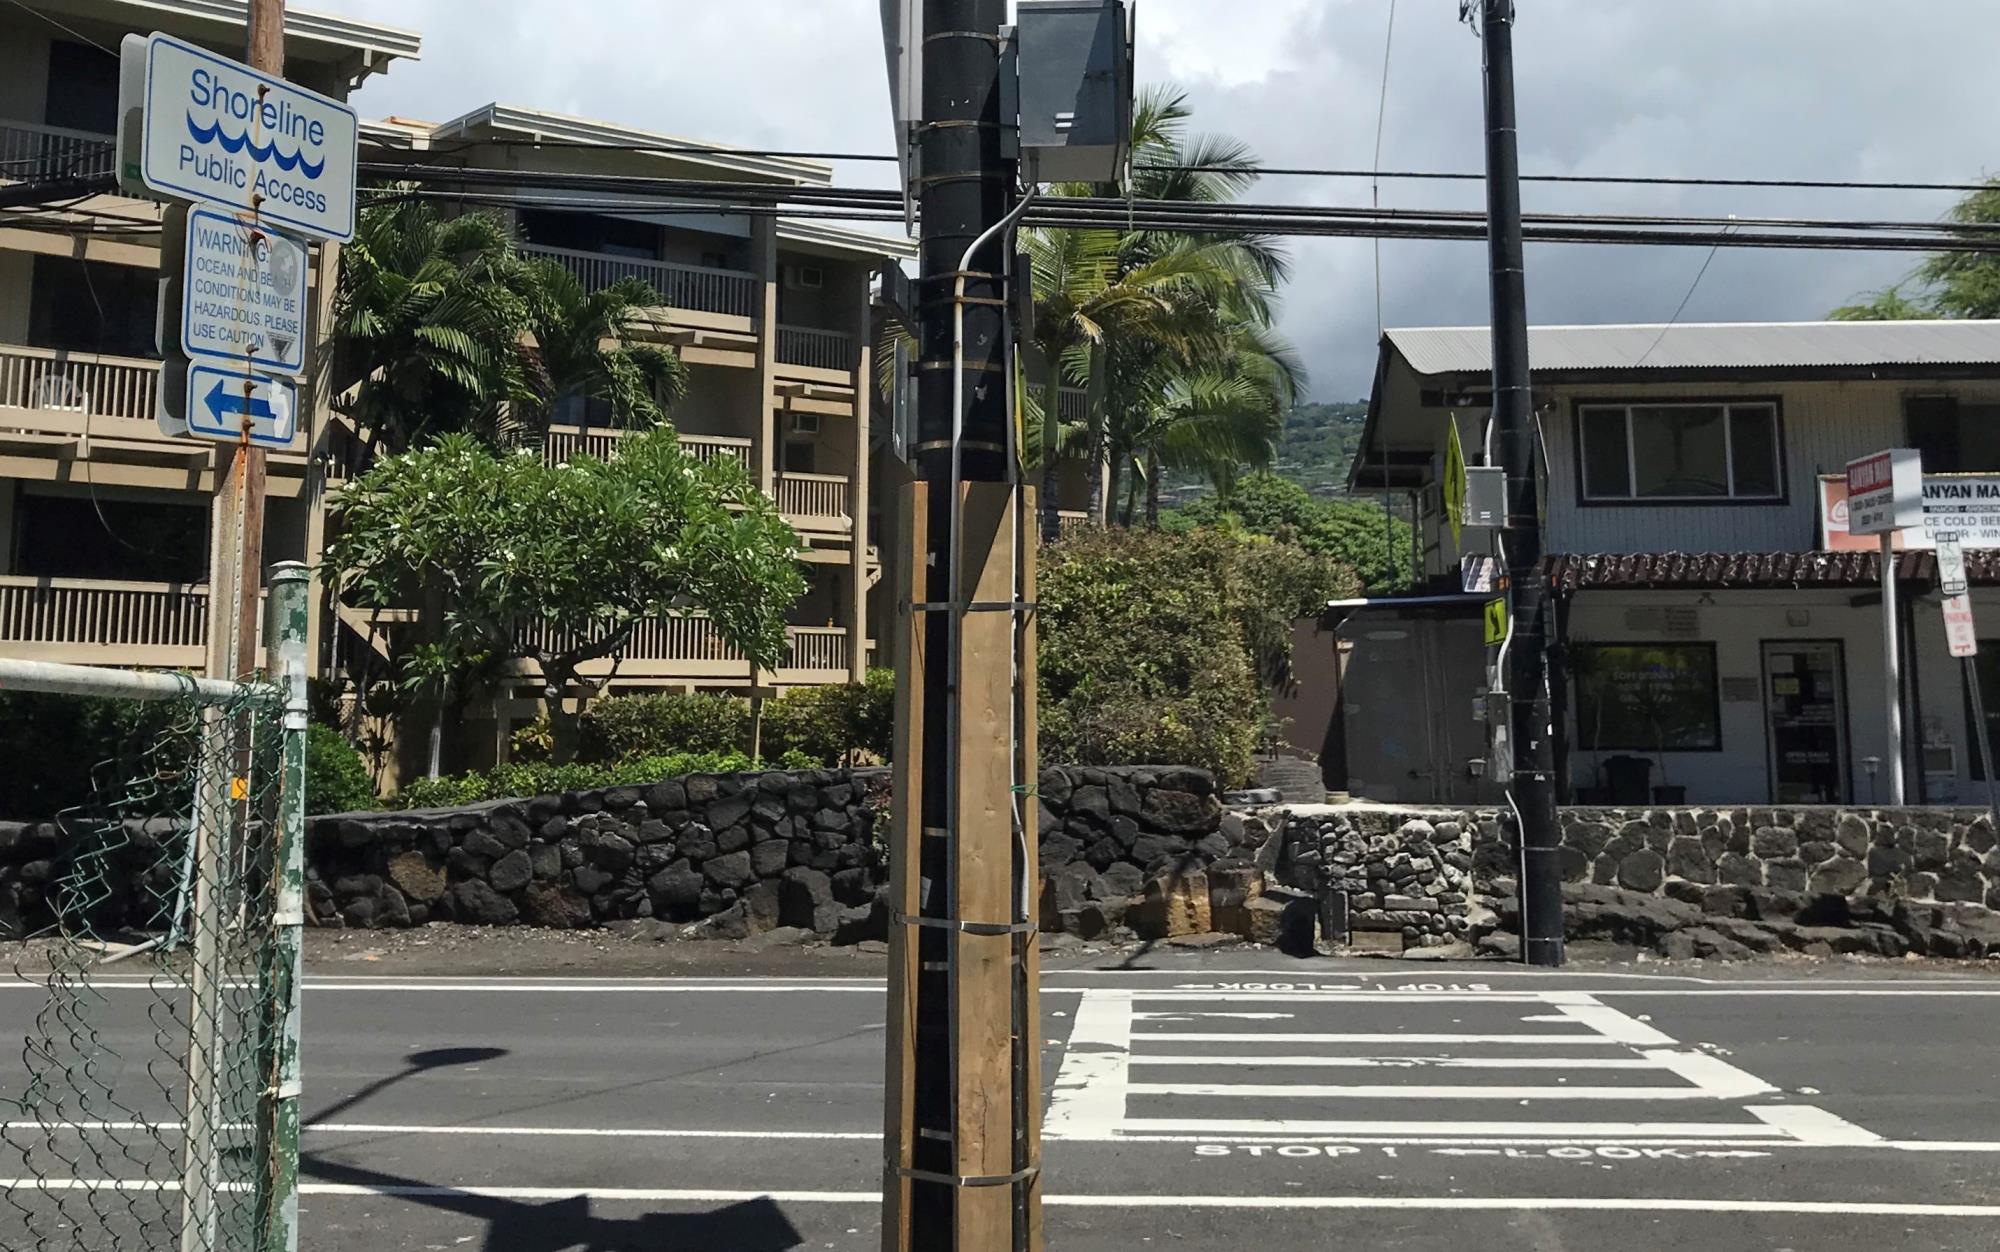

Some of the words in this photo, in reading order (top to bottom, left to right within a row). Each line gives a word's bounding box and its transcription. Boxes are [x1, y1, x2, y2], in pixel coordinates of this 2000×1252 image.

[190, 68, 325, 147] Shoreline
[179, 144, 247, 190] Public
[252, 168, 327, 214] Access
[195, 256, 235, 279] OCEAN
[236, 267, 258, 285] AND
[260, 271, 293, 289] BEH
[195, 278, 261, 305] CONDITIONS
[263, 293, 281, 309] MAY
[283, 299, 296, 314] BE
[193, 322, 216, 339] USE
[218, 325, 265, 347] CAUTION
[264, 315, 299, 335] PLEASE
[1922, 484, 1971, 499] ANYAN
[1923, 516, 1941, 527] CE
[1943, 516, 1977, 527] COLD
[1925, 529, 1969, 539] LIOR
